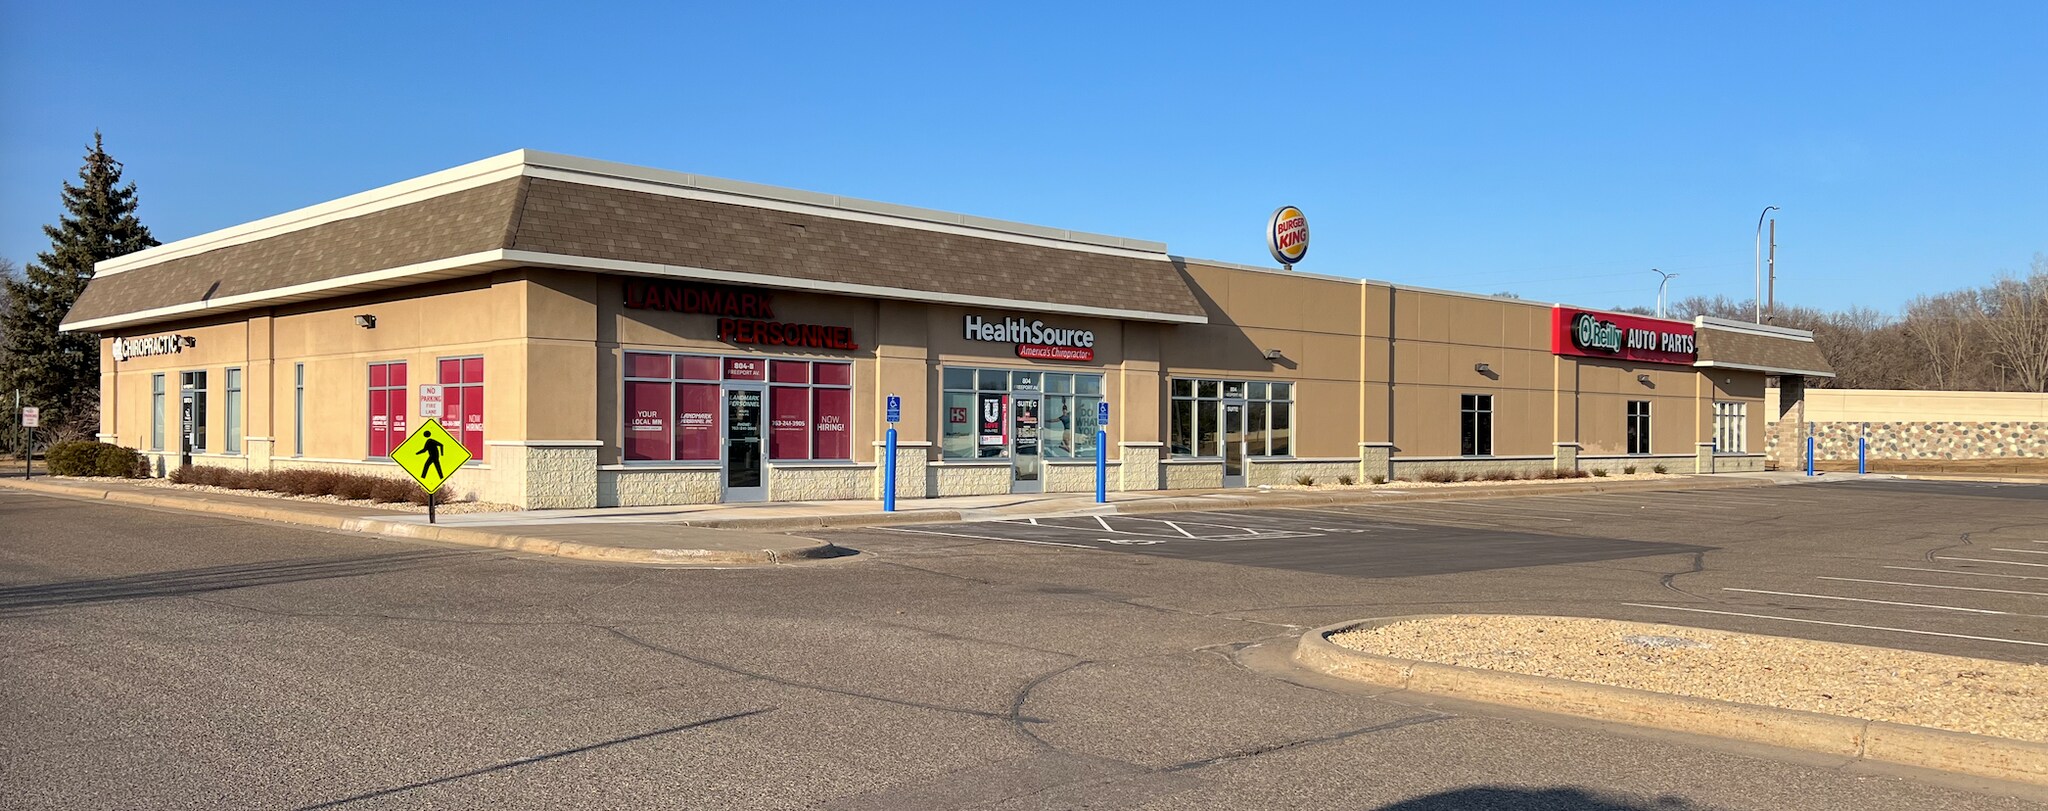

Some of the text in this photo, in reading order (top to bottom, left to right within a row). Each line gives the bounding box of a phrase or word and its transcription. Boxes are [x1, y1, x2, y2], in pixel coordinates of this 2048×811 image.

[1278, 217, 1304, 234] BURGER
[1279, 228, 1306, 249] KING
[625, 284, 775, 318] LANDMARK
[719, 318, 858, 350] PERSONNEL
[964, 315, 1094, 348] HealthSource
[122, 334, 177, 357] CHIROPRACTIC
[1628, 328, 1656, 350] AUTO
[1661, 332, 1694, 354] PARTS
[1020, 345, 1051, 357] America's
[637, 410, 657, 418] YOUR
[821, 415, 840, 423] NOW
[1081, 408, 1094, 417] DO
[816, 423, 845, 431] HIRING!
[1078, 427, 1096, 436] YOU
